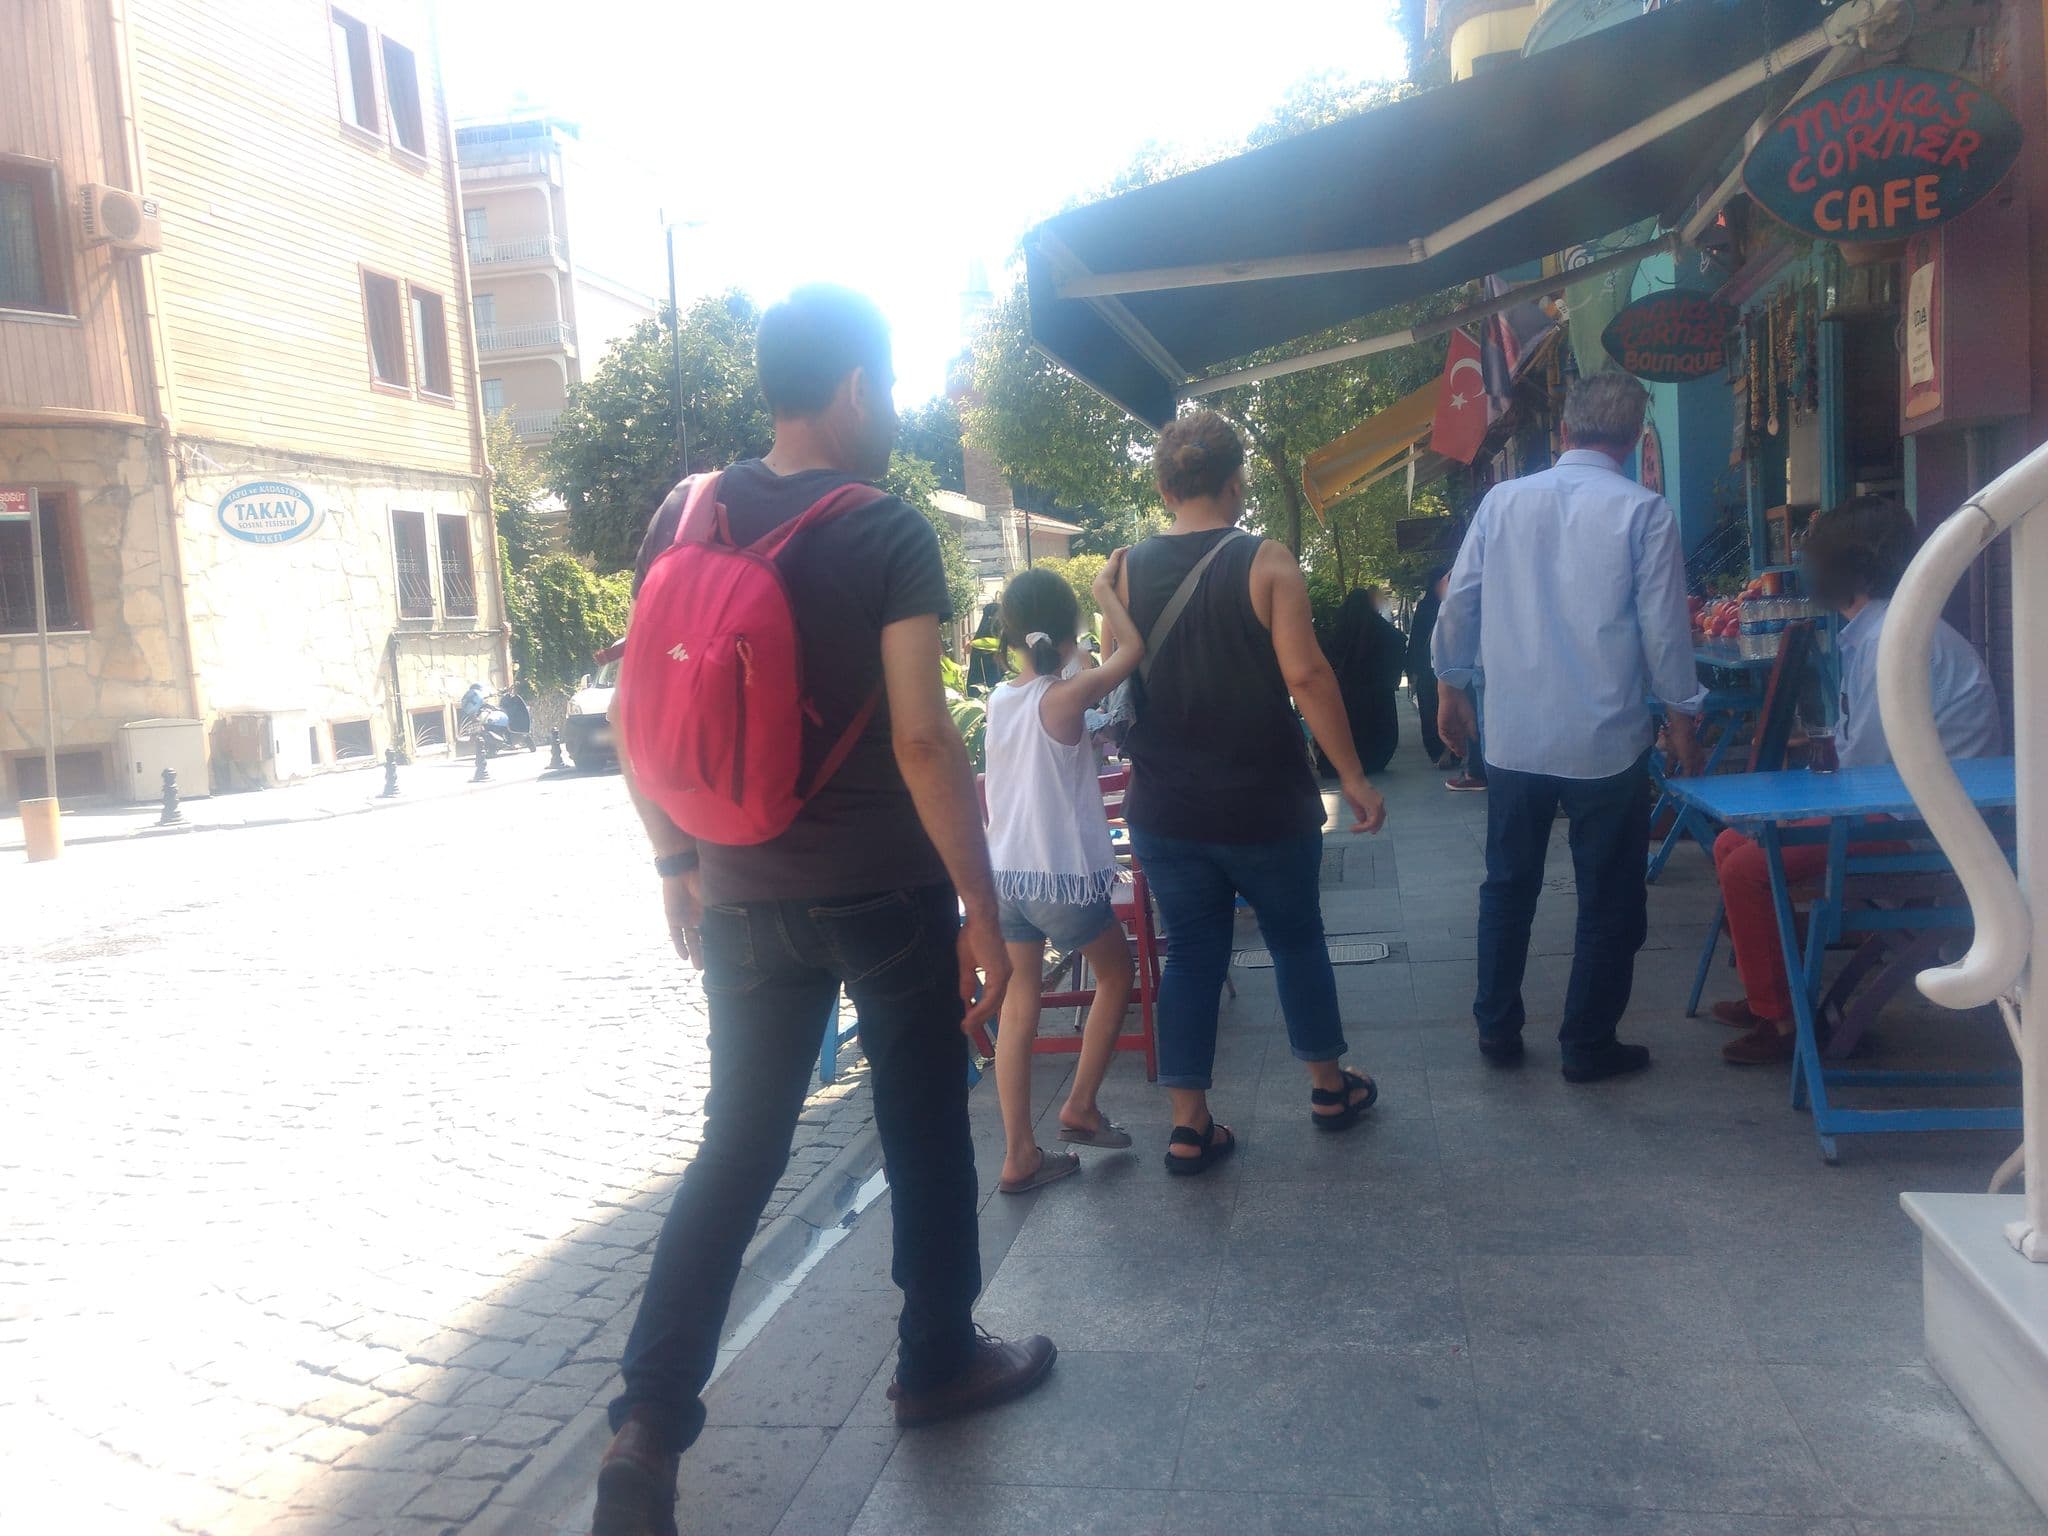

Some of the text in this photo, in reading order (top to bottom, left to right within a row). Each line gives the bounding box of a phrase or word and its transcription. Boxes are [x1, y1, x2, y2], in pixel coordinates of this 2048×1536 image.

[1813, 175, 1941, 232] CAFE
[1624, 350, 1722, 372] BOUTIQUE
[234, 500, 298, 521] TAKAV
